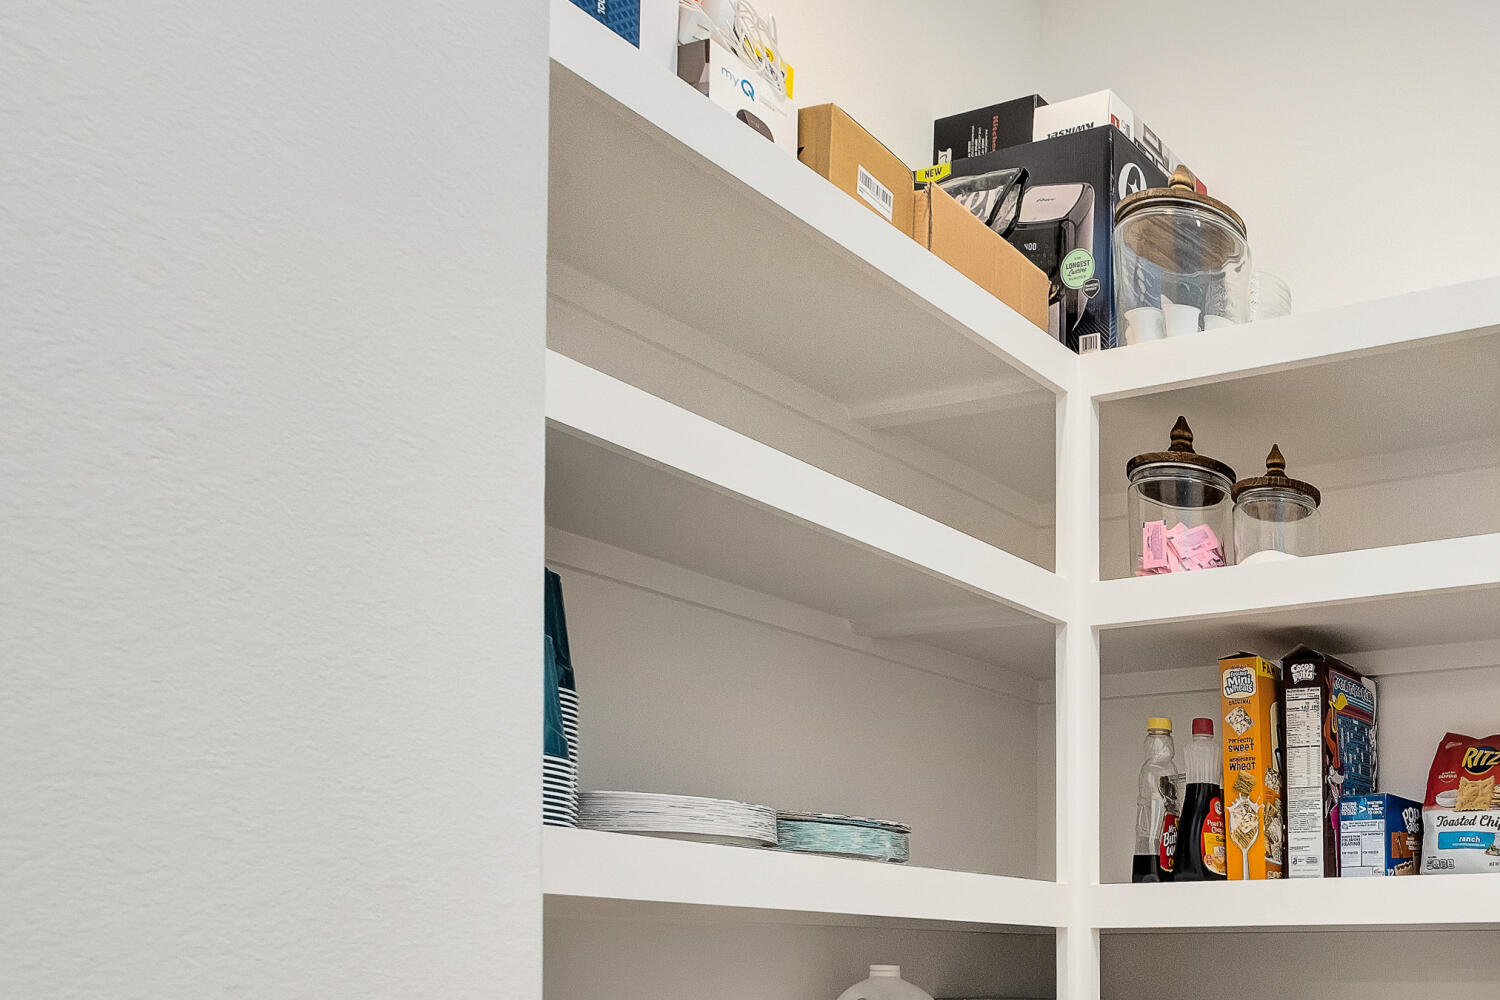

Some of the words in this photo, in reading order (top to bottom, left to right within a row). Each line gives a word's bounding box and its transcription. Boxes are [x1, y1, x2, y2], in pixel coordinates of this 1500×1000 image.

[924, 167, 943, 179] NEW
[1066, 260, 1091, 271] LONGEST
[1227, 674, 1252, 686] Mini
[1224, 682, 1253, 696] Wheats
[1228, 742, 1255, 753] sweet
[1230, 761, 1256, 771] wheat
[1436, 814, 1477, 828] Toasted
